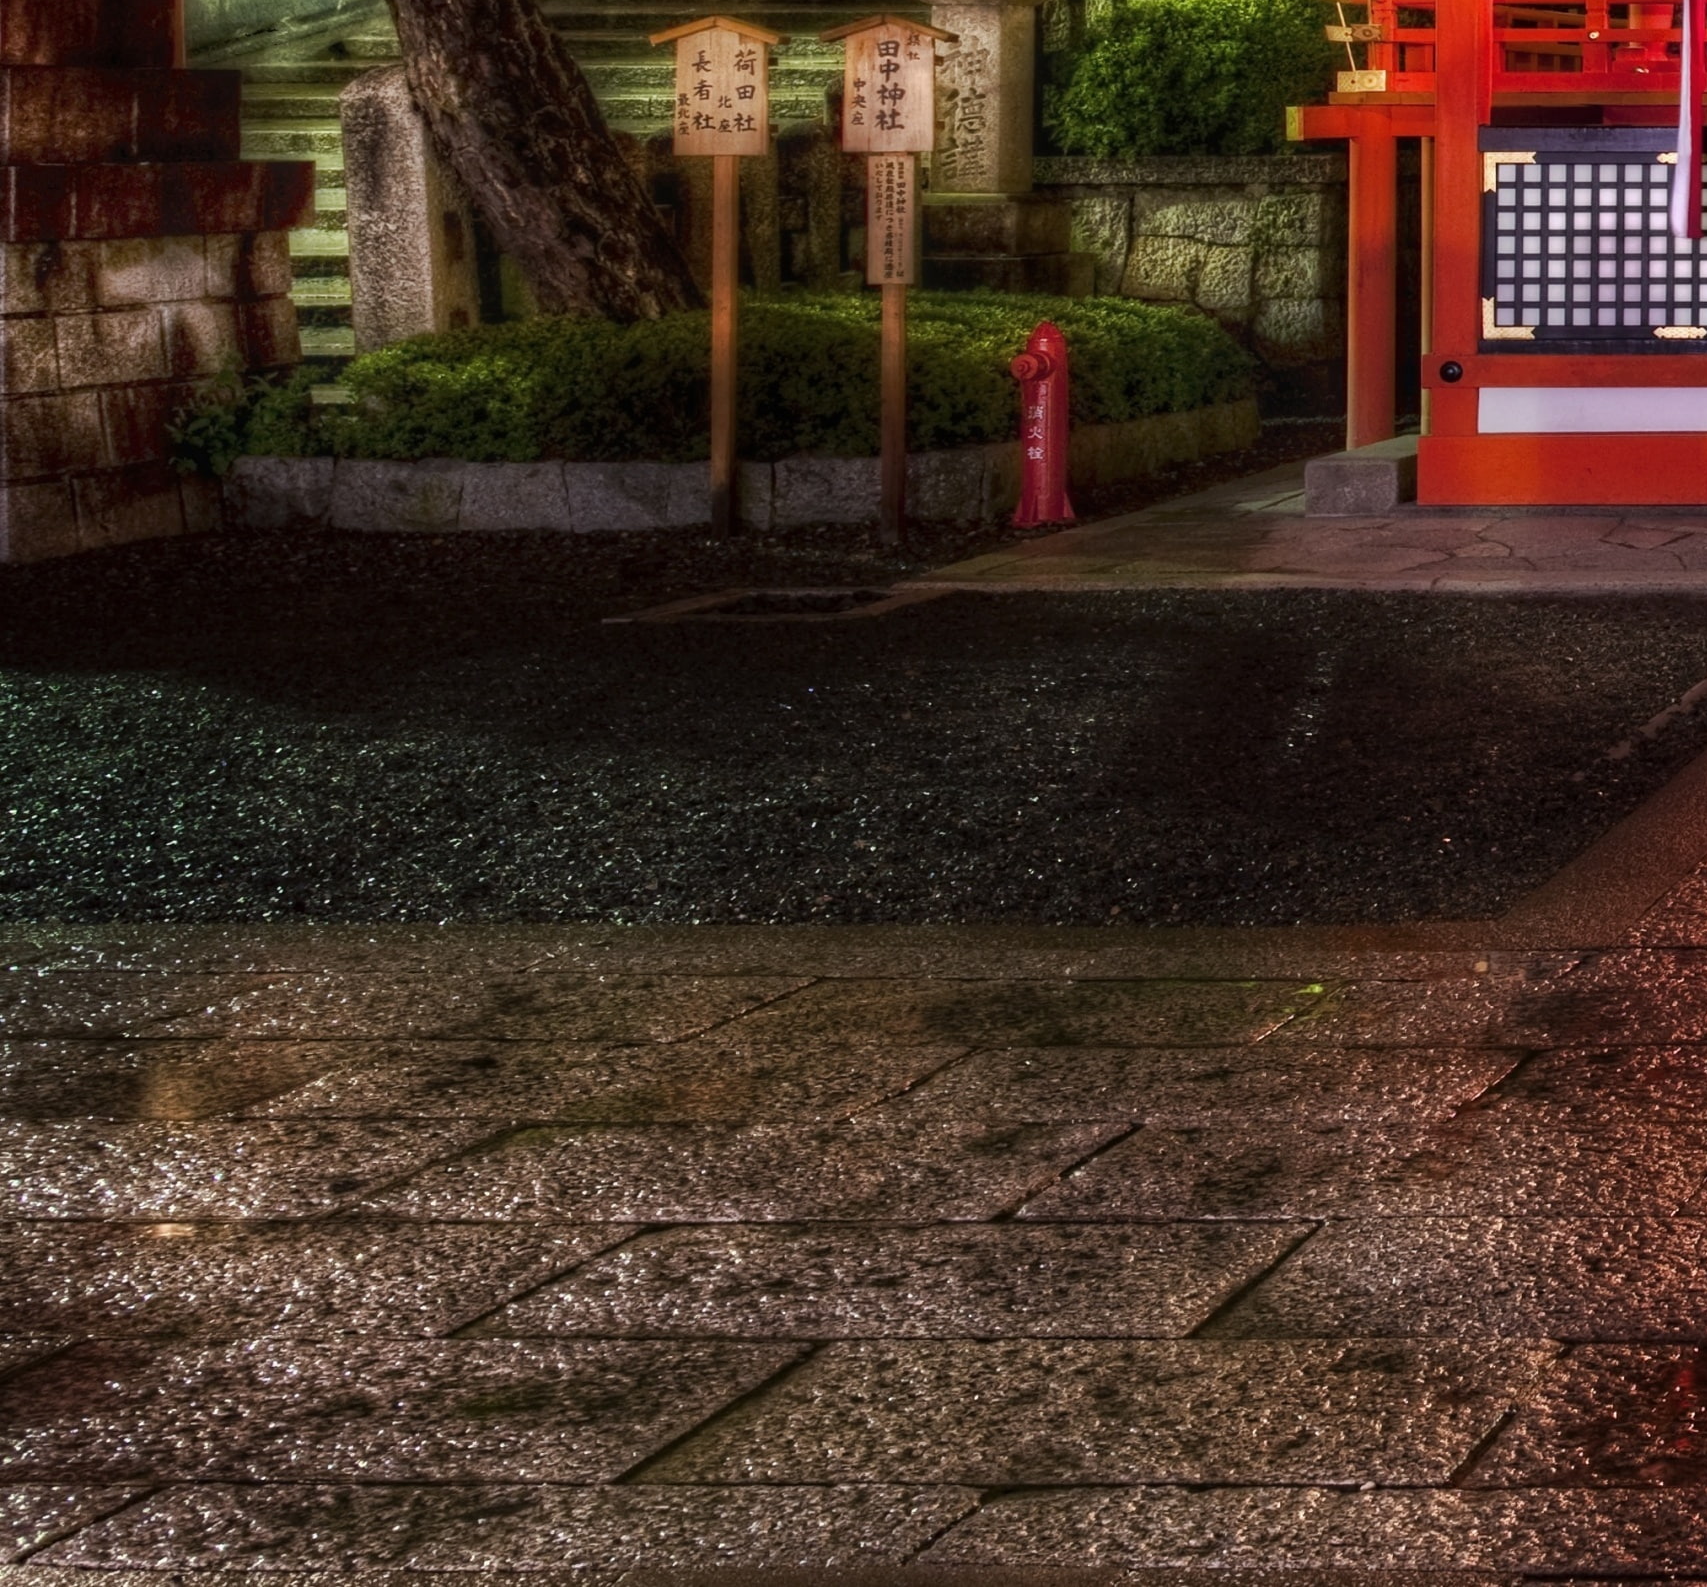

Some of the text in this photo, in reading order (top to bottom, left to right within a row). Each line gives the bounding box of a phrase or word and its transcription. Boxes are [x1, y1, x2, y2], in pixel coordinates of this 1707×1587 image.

[691, 49, 716, 131] 長者社
[733, 48, 758, 132] 荷田社
[851, 77, 867, 126] 中央座
[874, 39, 906, 131] 田中神社
[677, 93, 690, 136] 最北座
[717, 95, 732, 133] 北座
[1027, 405, 1044, 460] 消火栓
